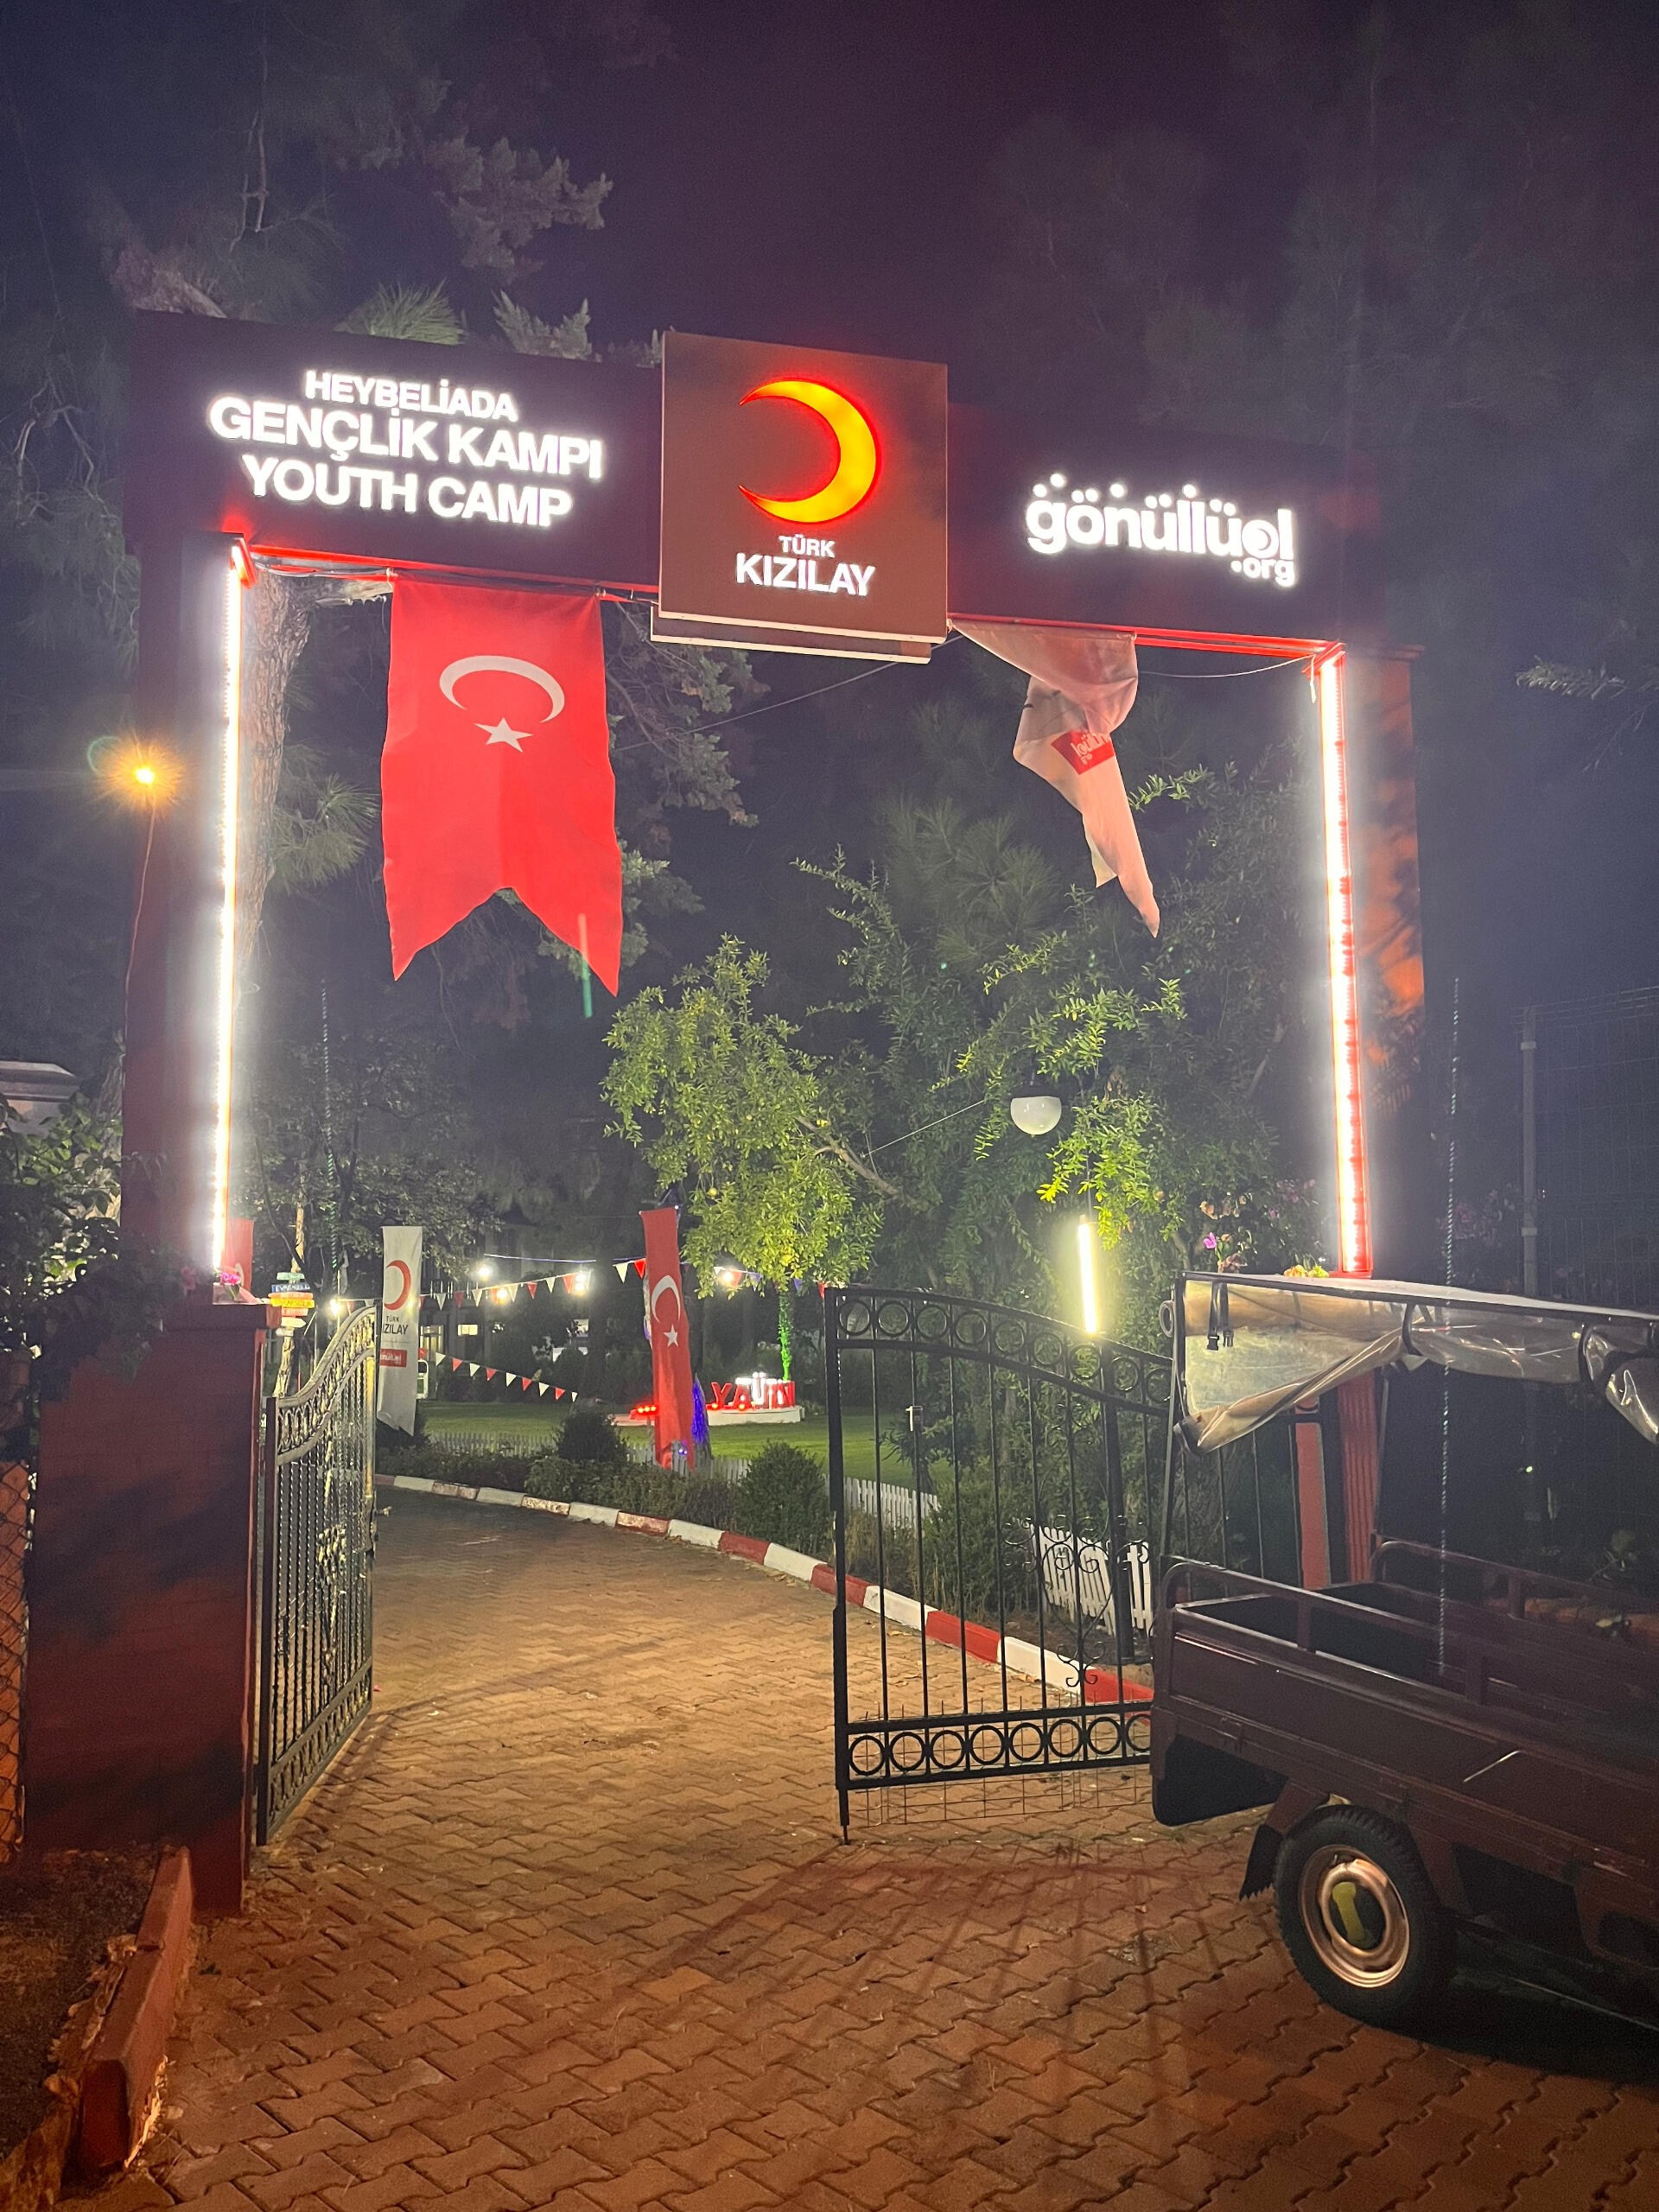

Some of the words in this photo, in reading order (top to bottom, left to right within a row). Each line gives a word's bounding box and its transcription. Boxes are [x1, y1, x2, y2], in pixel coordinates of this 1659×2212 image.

[306, 371, 518, 423] HEYBELİADA
[209, 397, 437, 461] GENÇLİK
[448, 424, 603, 479] KAMPI
[242, 454, 417, 513] YOUTH
[428, 476, 572, 527] CAMP
[779, 533, 836, 558] TÜRK
[736, 552, 876, 597] KIZILAY
[1230, 557, 1296, 588] .org
[383, 1323, 409, 1335] IZILAY
